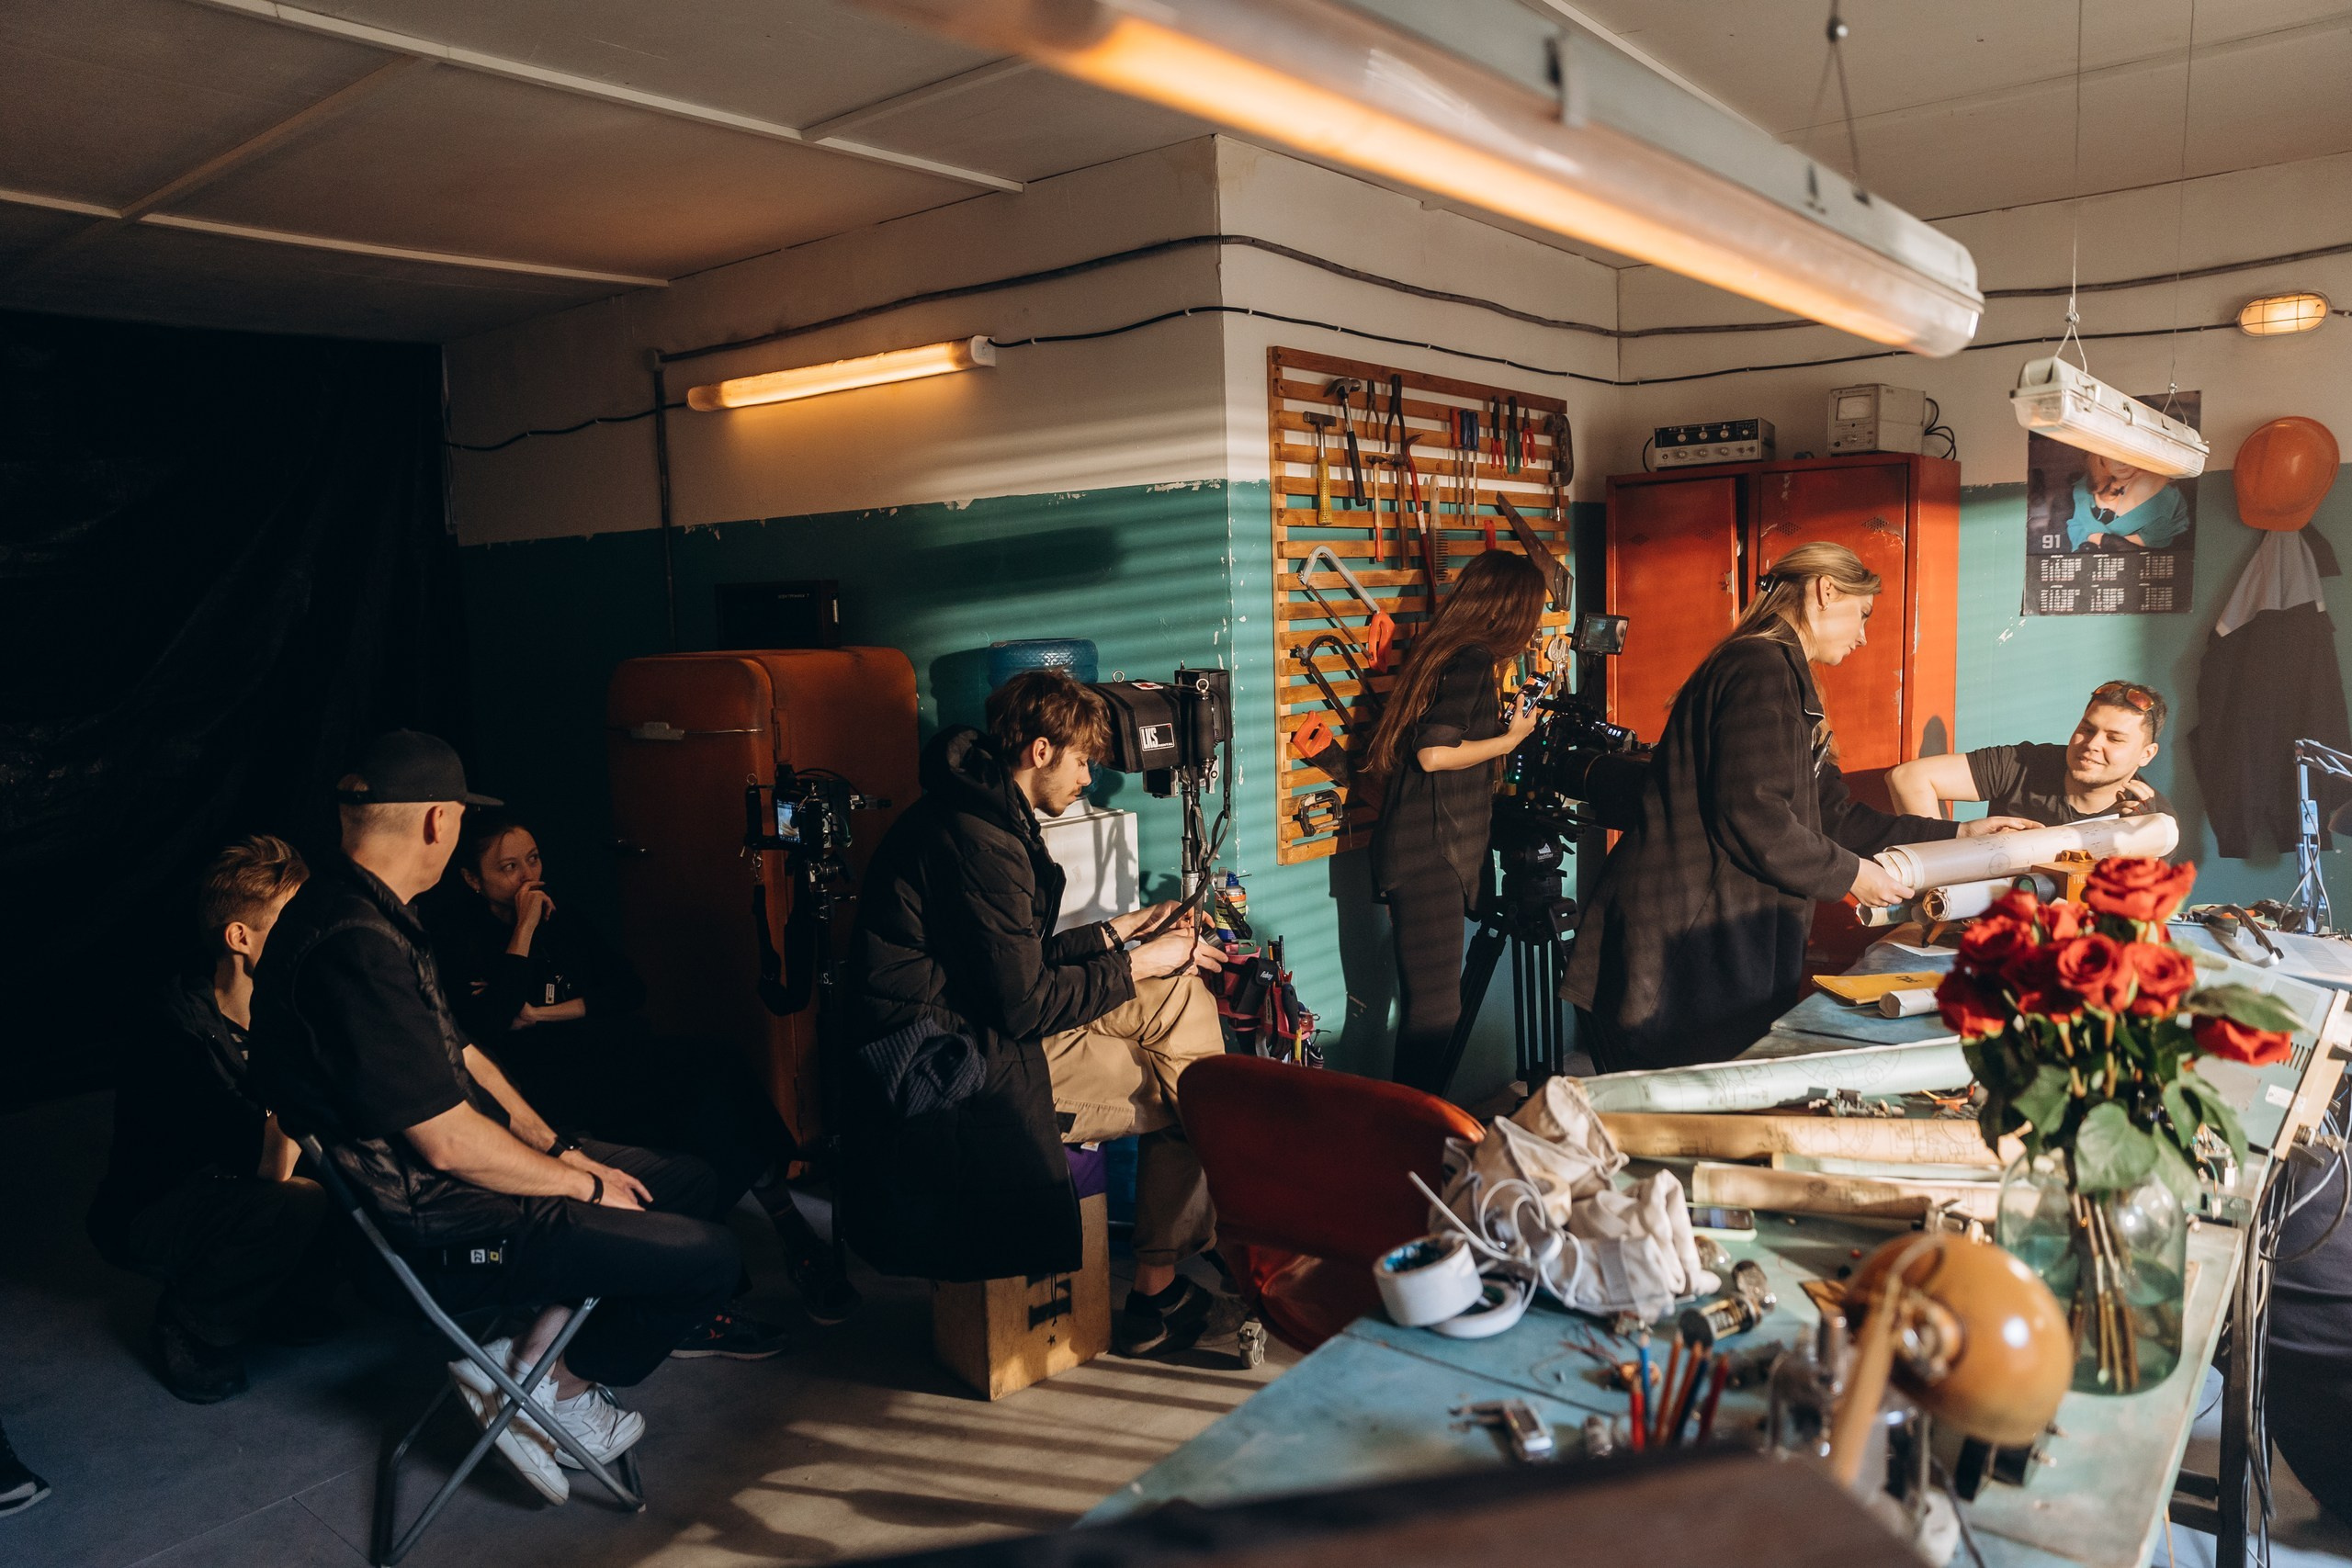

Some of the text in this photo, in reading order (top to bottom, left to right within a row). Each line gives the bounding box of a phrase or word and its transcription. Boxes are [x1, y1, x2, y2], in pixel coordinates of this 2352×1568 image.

[2041, 534, 2061, 549] 91
[1141, 727, 1159, 750] LKS
[1537, 852, 1554, 861] sachtler
